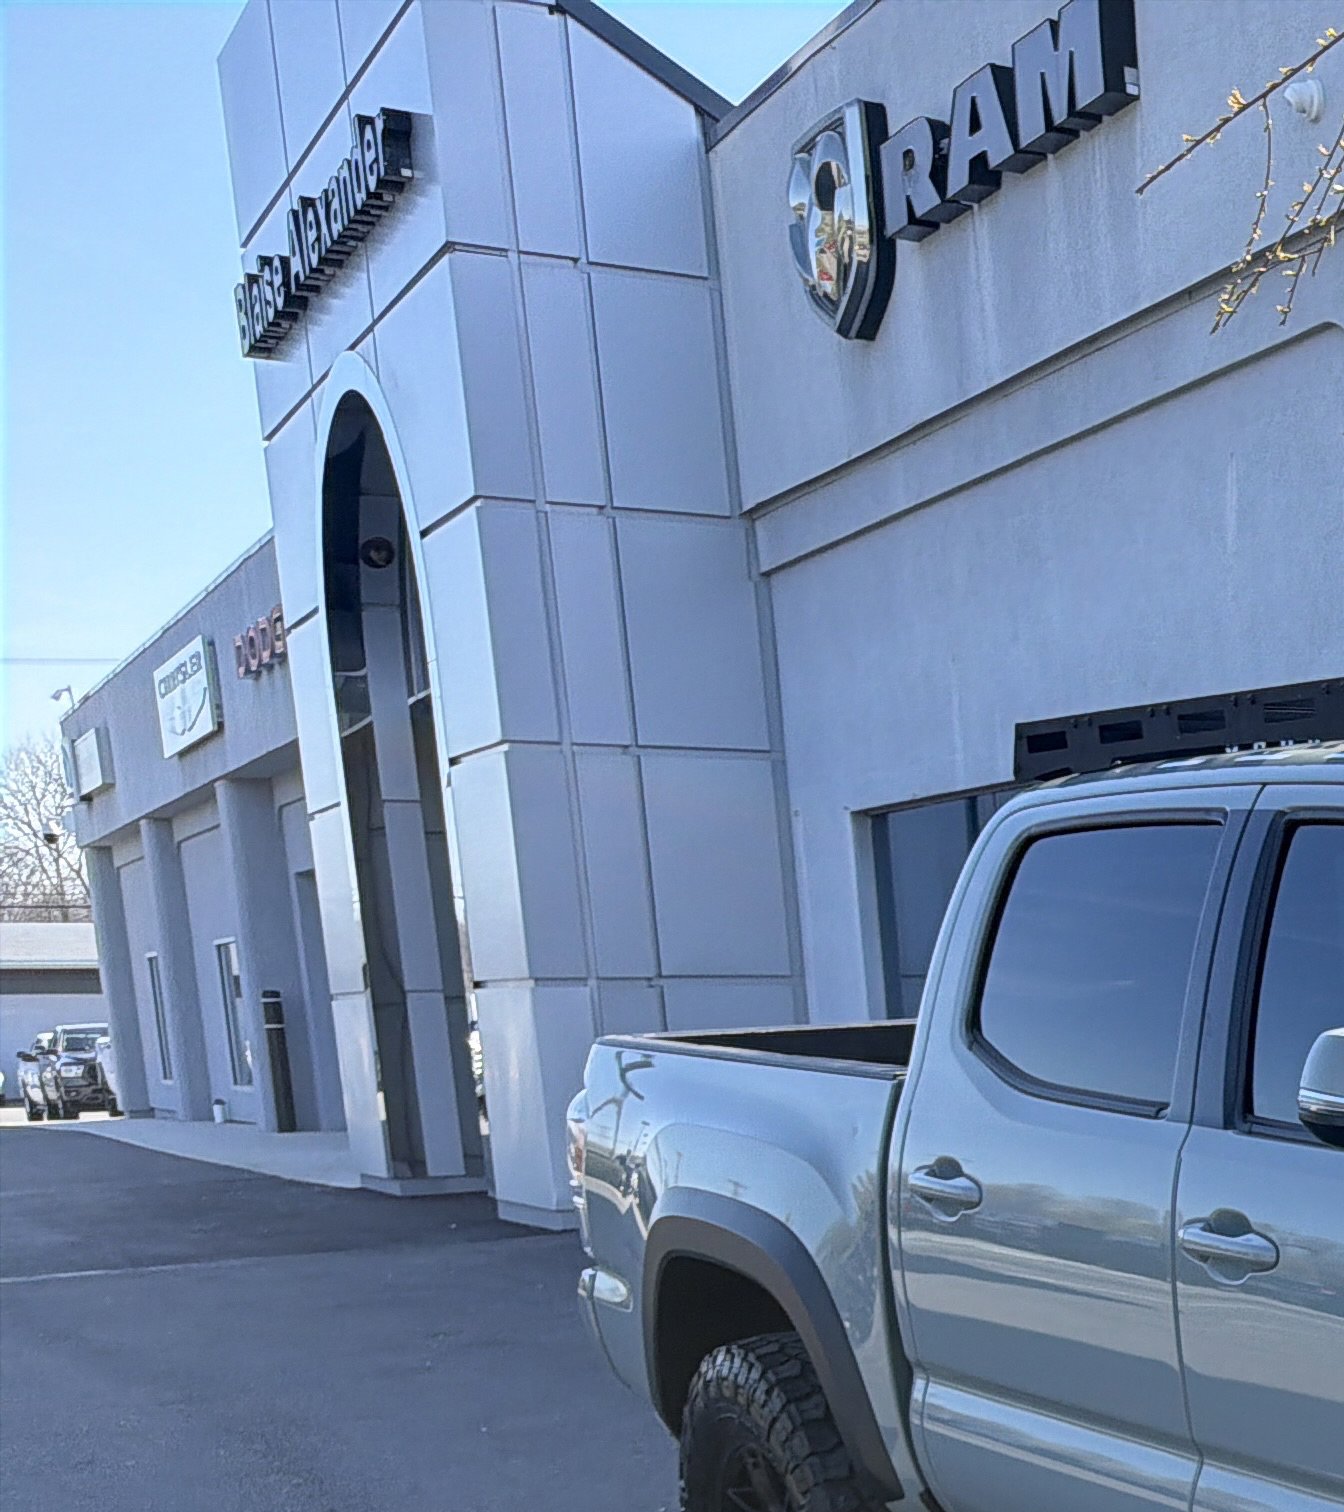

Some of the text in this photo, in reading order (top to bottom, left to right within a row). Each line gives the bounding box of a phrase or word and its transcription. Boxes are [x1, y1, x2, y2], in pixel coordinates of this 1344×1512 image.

[234, 107, 388, 357] Blaise Alexander
[879, 0, 1106, 239] RAM
[233, 603, 288, 680] DODG
